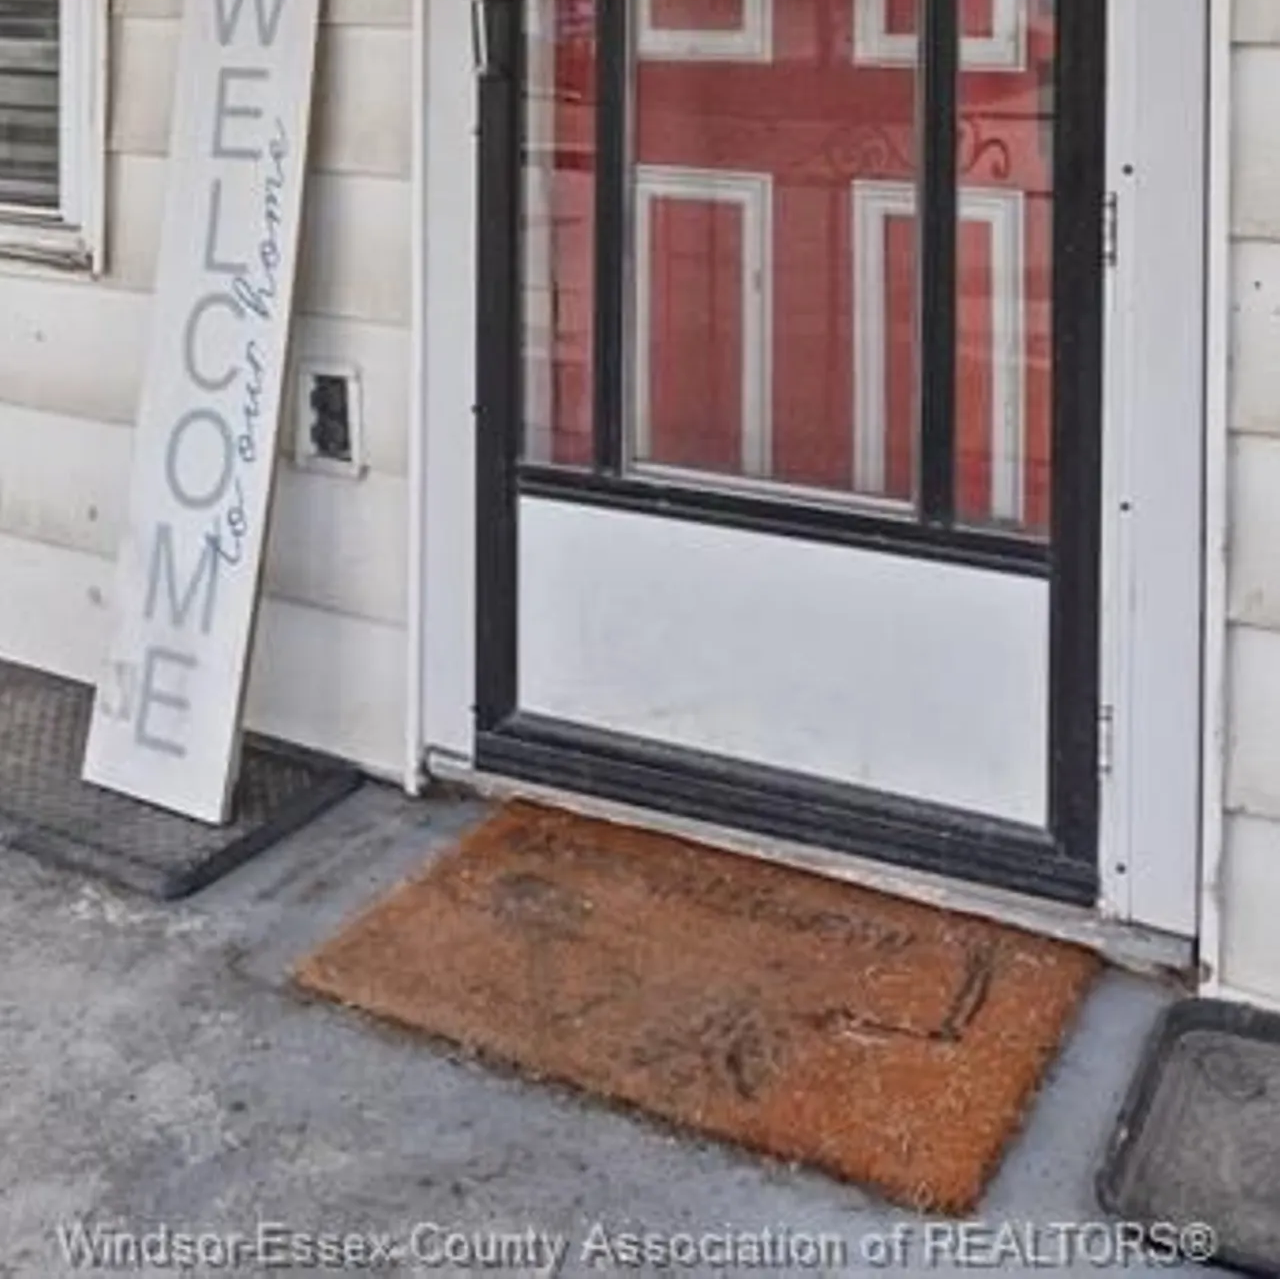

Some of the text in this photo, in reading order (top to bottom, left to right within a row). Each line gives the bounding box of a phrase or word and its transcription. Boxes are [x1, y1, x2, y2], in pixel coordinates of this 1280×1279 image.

[205, 115, 290, 565] to our home
